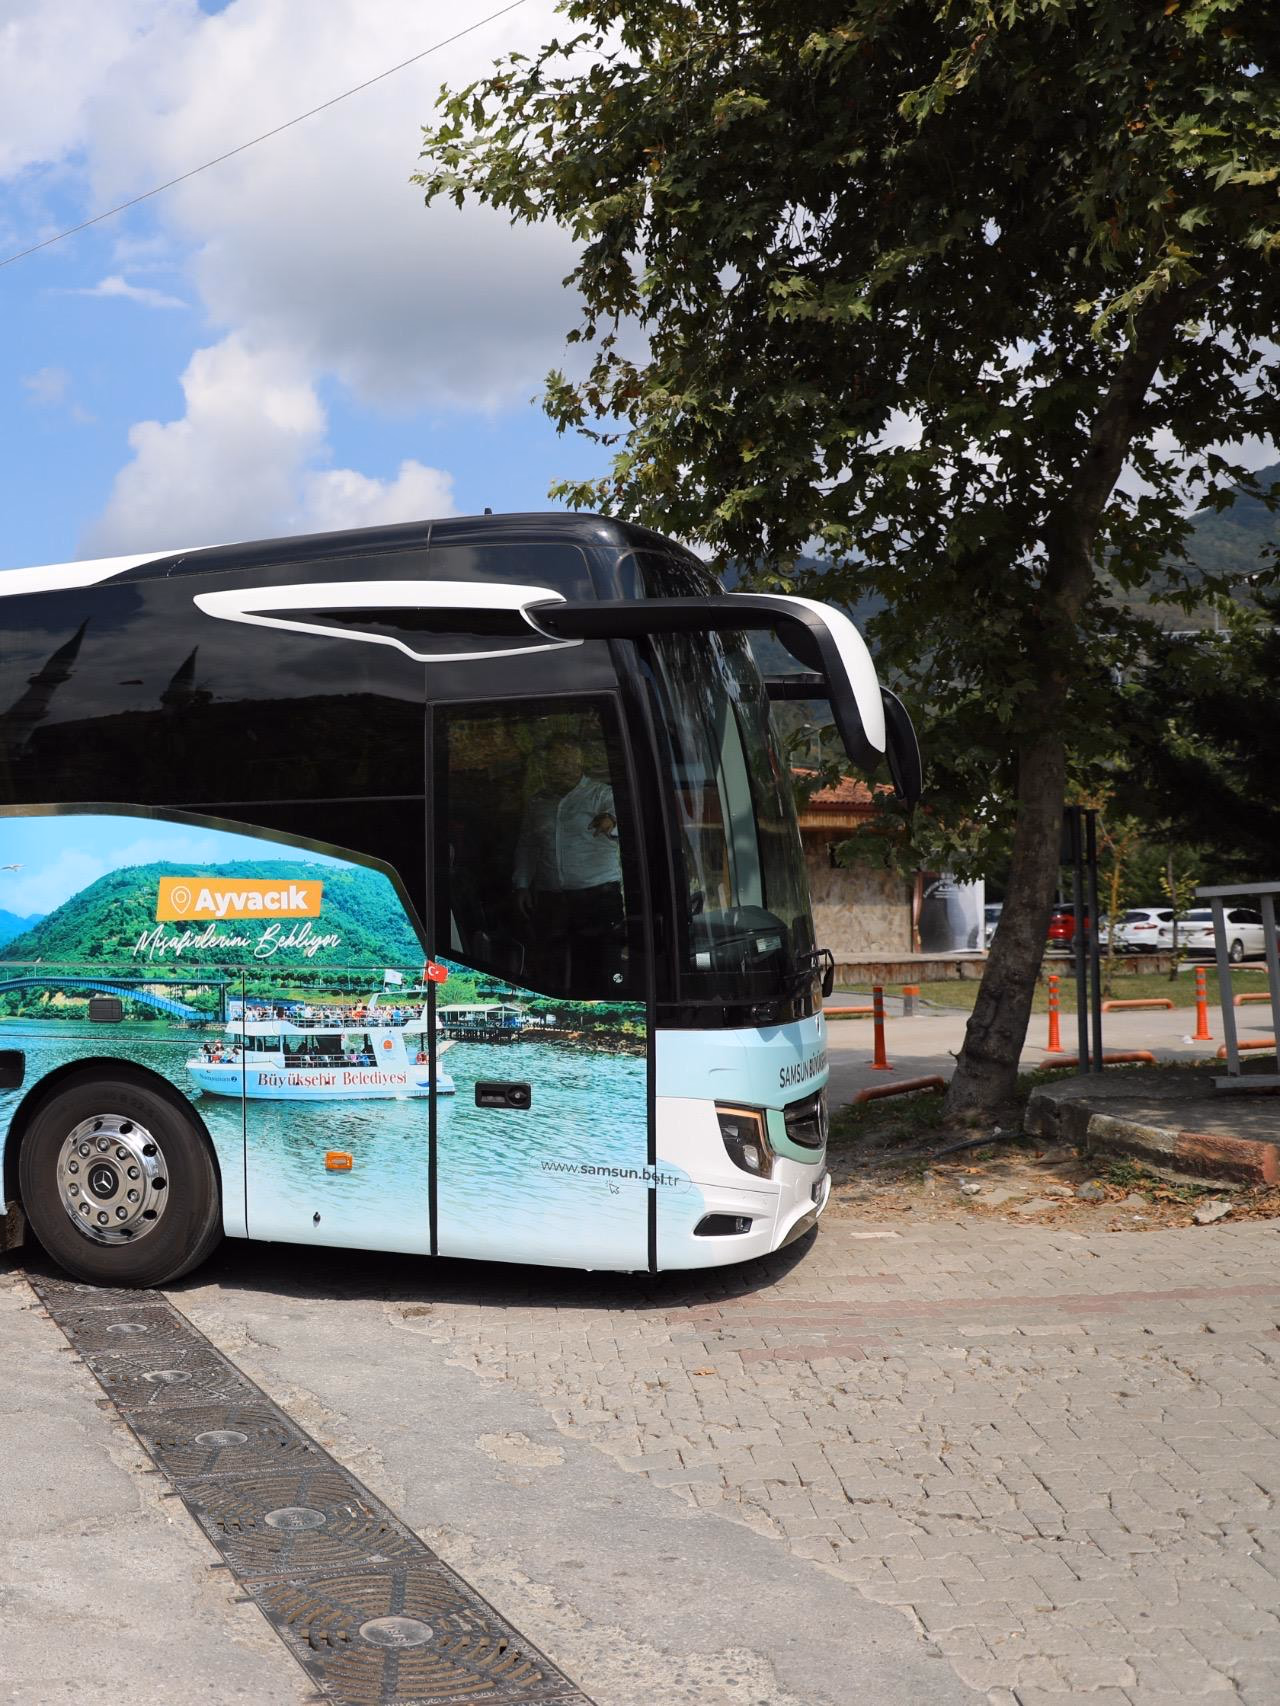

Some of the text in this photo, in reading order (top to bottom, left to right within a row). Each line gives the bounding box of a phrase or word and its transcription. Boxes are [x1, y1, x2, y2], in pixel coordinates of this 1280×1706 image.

[194, 885, 308, 917] Ayvacık
[133, 921, 342, 960] Misafirlerini Bekliyor
[258, 1072, 337, 1089] Büyükşehir
[343, 1071, 407, 1088] Belediyesi
[779, 1059, 810, 1089] SAMSUN
[540, 1160, 680, 1187] www.samsun.bel.tr
